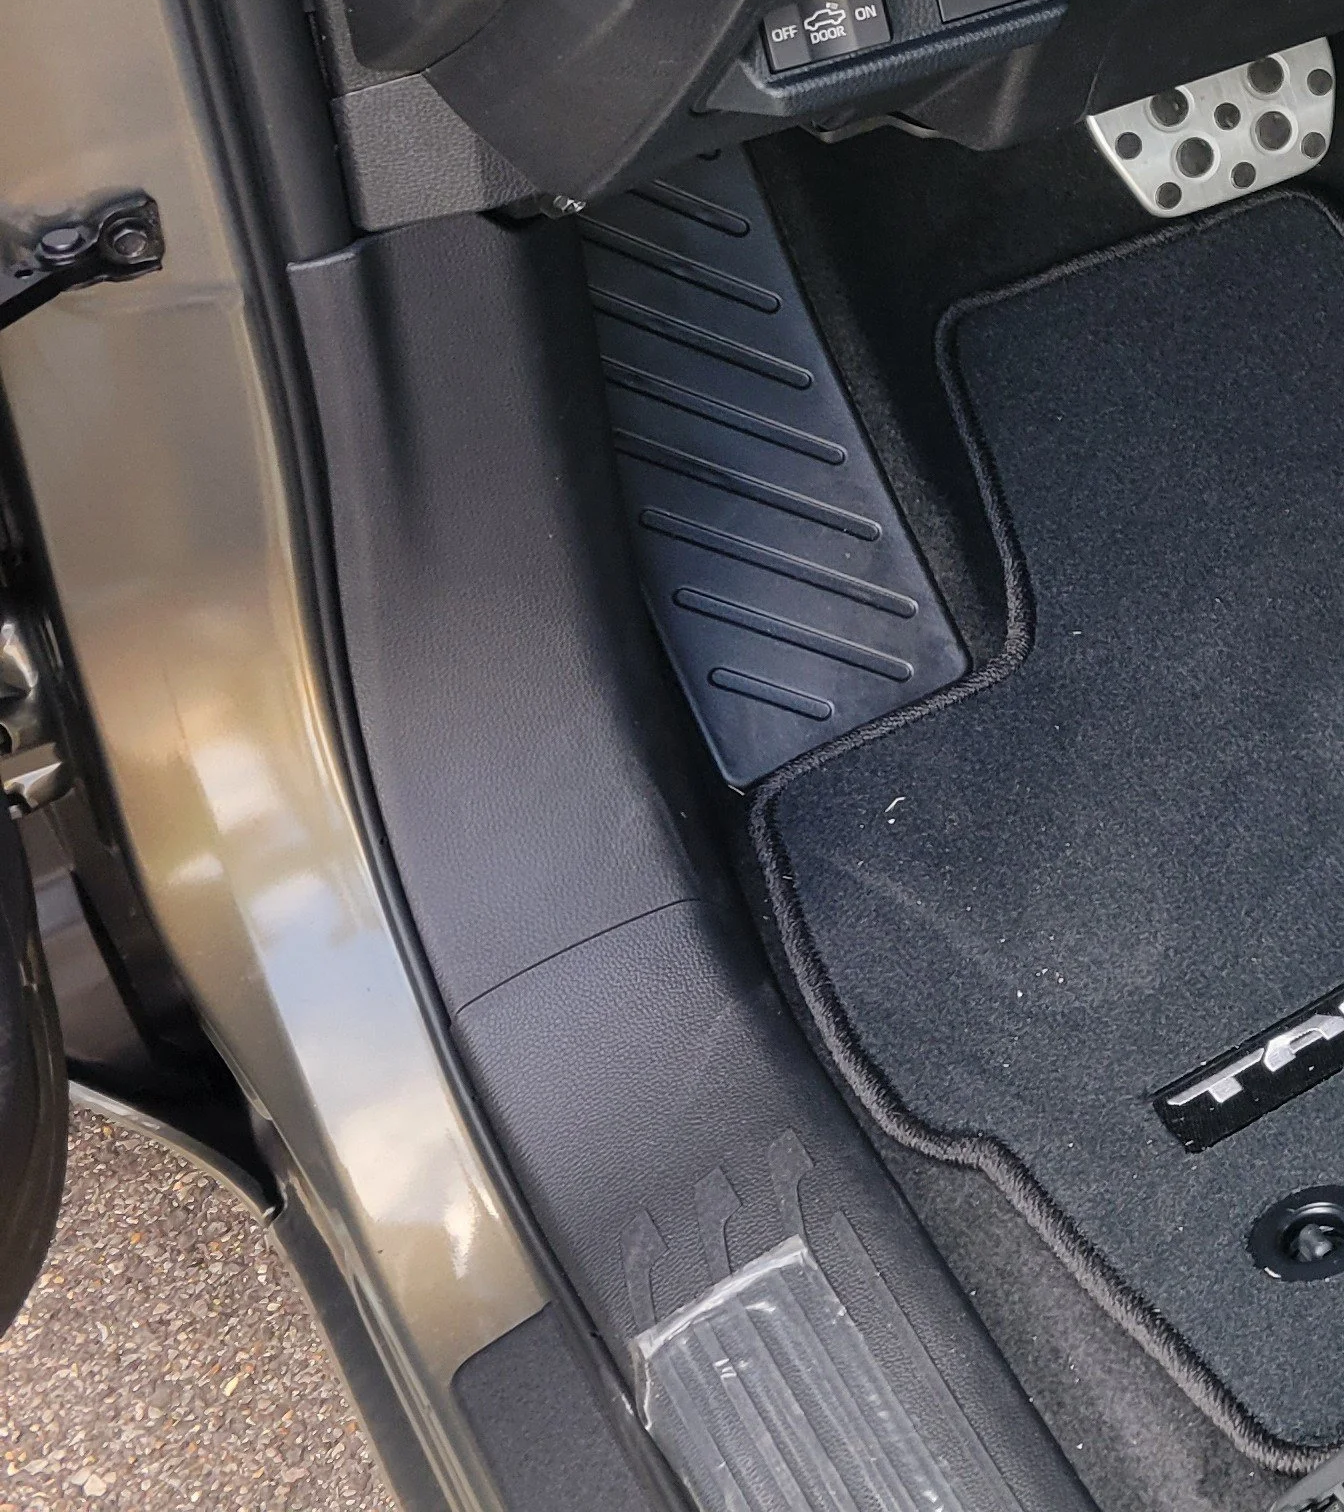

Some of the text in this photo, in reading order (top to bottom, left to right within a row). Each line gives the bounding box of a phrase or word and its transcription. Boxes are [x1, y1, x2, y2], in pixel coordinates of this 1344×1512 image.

[771, 3, 878, 45] OFF DOOR ON
